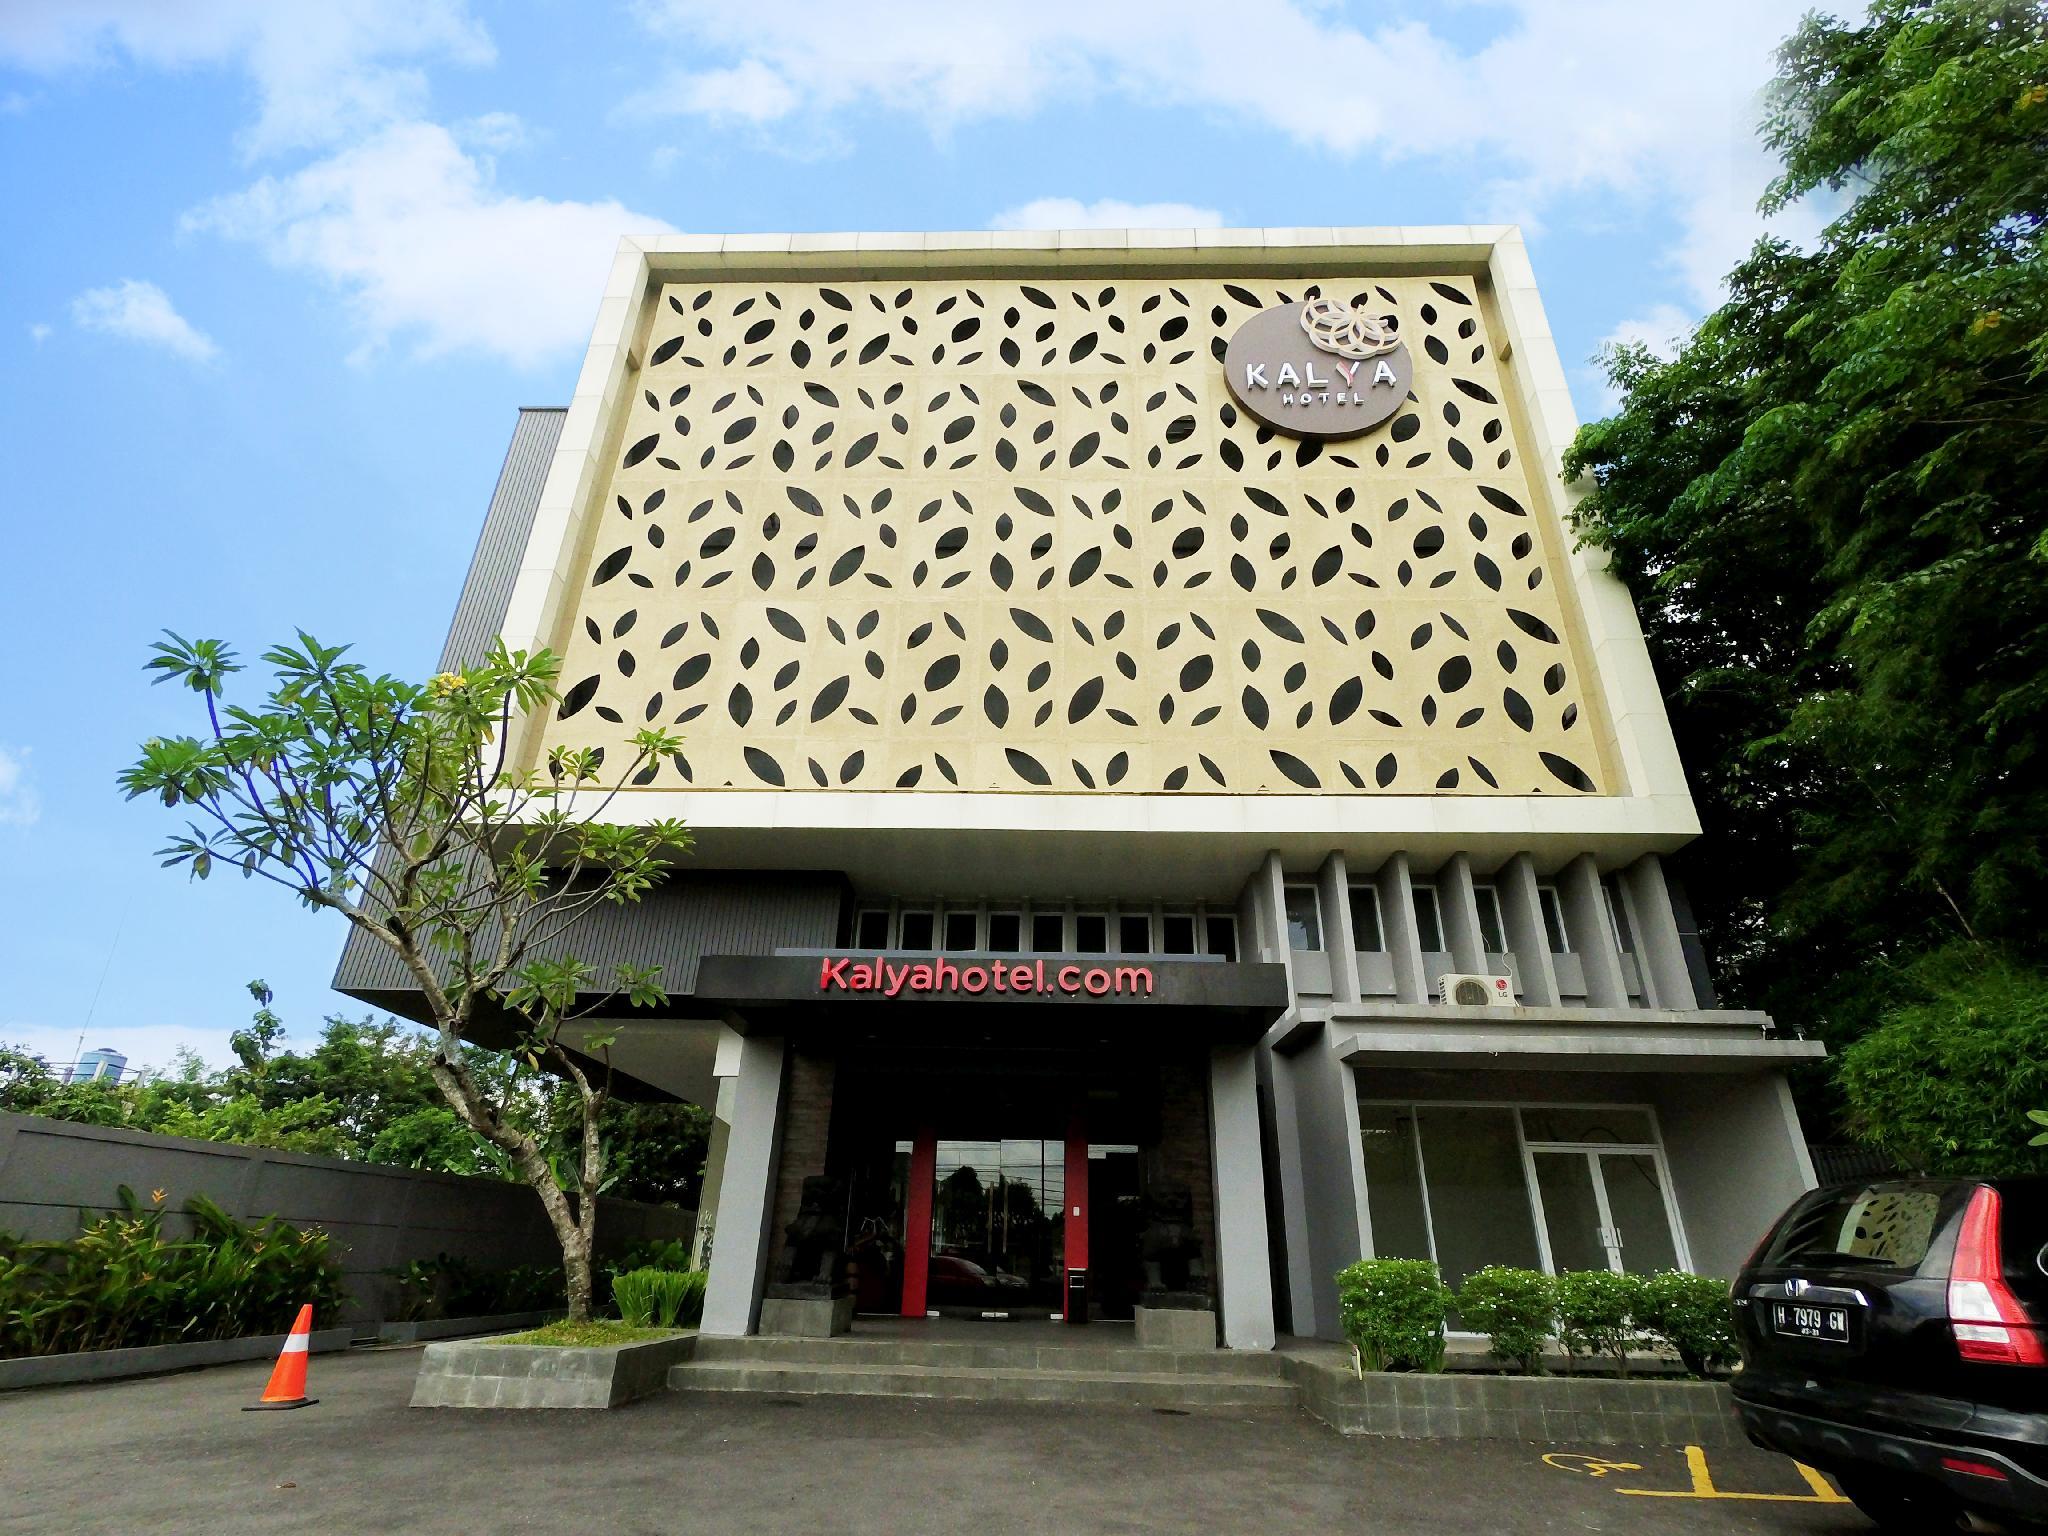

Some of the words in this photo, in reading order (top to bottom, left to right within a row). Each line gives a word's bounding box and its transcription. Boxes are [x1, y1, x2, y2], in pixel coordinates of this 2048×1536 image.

[1246, 361, 1396, 388] KALYA
[1283, 392, 1364, 406] HOTEL
[820, 957, 1153, 996] Kalyahotel.com
[1778, 1306, 1785, 1324] H
[1793, 1307, 1821, 1328] 7979
